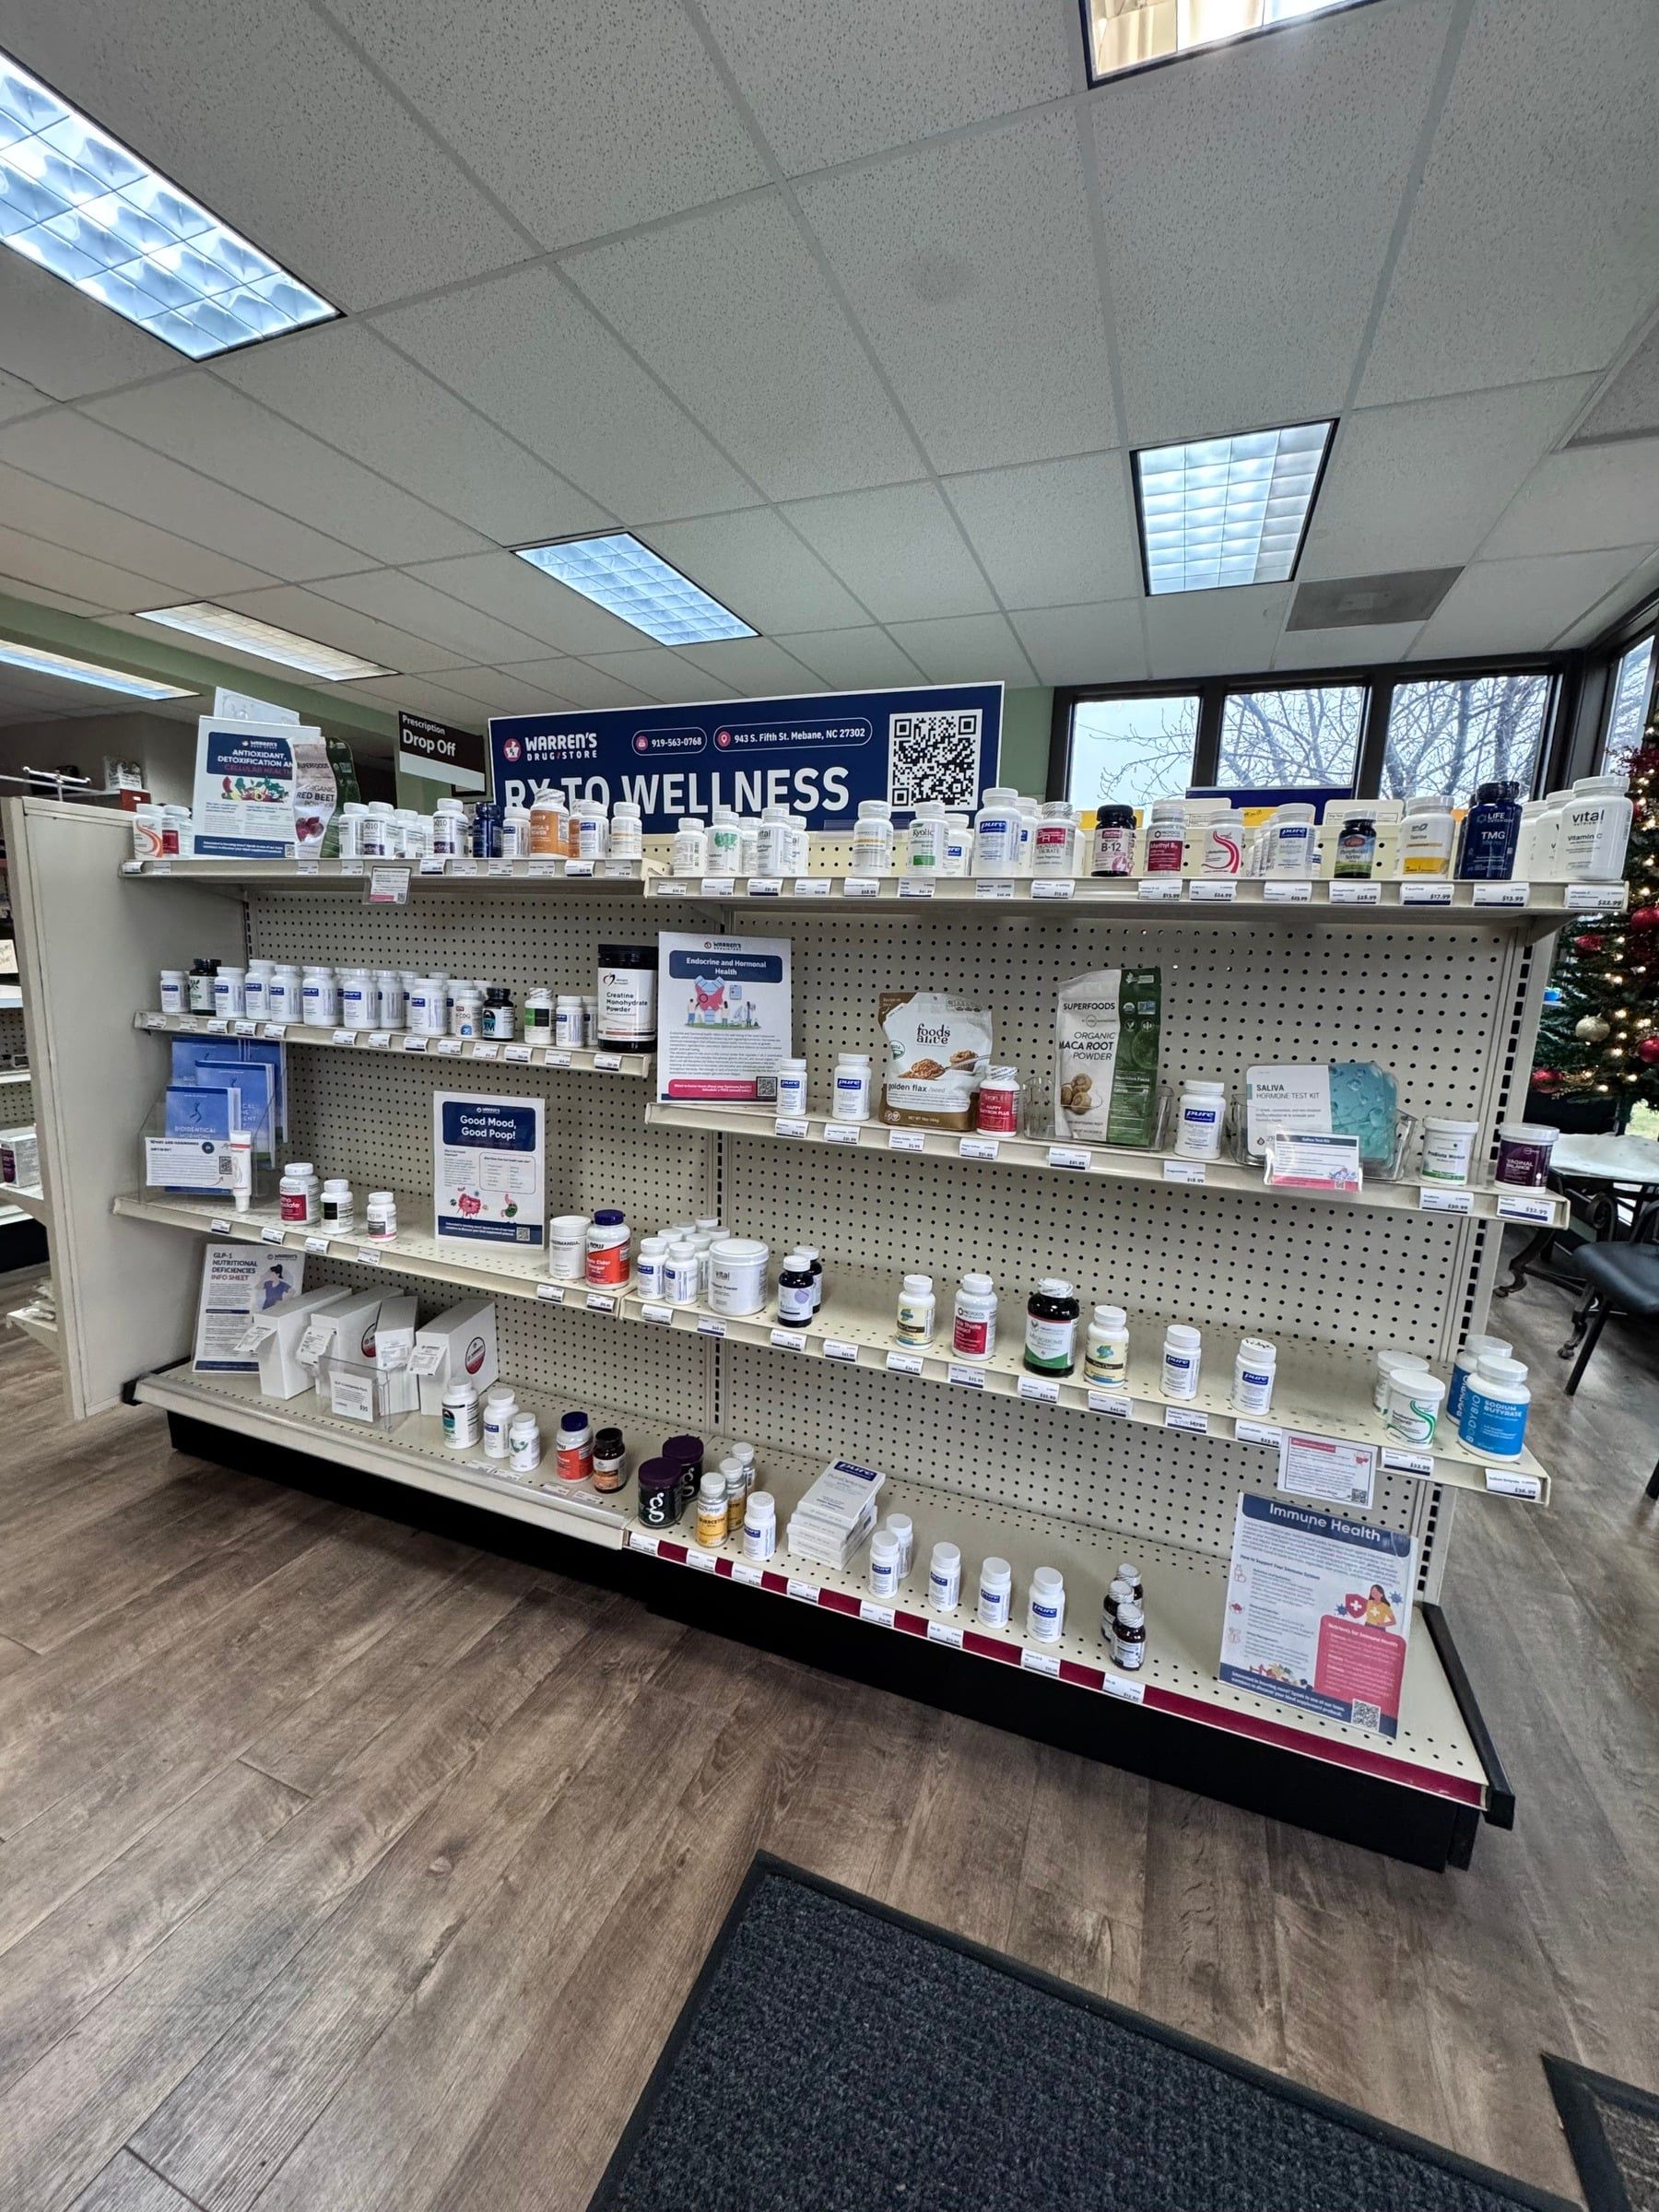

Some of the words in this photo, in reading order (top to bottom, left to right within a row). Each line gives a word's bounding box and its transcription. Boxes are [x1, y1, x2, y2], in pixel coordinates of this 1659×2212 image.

[402, 714, 445, 735] Prescription
[734, 734, 749, 744] 943
[749, 734, 759, 743] S.
[759, 733, 778, 743] Fifth
[779, 732, 790, 741] St.
[791, 730, 825, 741] Mebane,
[826, 729, 839, 738] NC
[839, 727, 865, 738] 27302
[403, 729, 435, 754] Drop
[437, 738, 457, 757] Off
[524, 732, 598, 752] WARREN'S
[652, 736, 702, 747] 919-563-0768
[231, 748, 287, 760] ANTIOXIDANT,
[217, 755, 282, 768] DETOXIFICATION
[560, 776, 611, 816] TO
[621, 766, 850, 816] WELLNESS
[296, 791, 312, 800] RED
[314, 793, 335, 803] BEET
[1571, 809, 1606, 824] vital
[981, 821, 1006, 830] pure
[912, 829, 935, 838] Kyolic
[1480, 830, 1506, 841] TMG
[1568, 833, 1594, 841] Vitamin
[1100, 842, 1122, 853] B-12
[686, 957, 720, 967] Endocrine
[735, 960, 767, 969] Hormonal
[714, 968, 737, 976] Health
[606, 998, 649, 1007] Monohydrate
[1063, 1002, 1116, 1011] SUPERFOODS
[916, 1023, 951, 1038] foods
[1074, 1031, 1116, 1041] ORGANIC
[916, 1035, 949, 1045] alive
[1086, 1041, 1114, 1051] ROOT
[1072, 1053, 1113, 1061] POWDER
[888, 1083, 911, 1093] golden
[912, 1082, 927, 1092] flax
[1255, 1084, 1285, 1092] SALIVA
[1185, 1109, 1216, 1119] pure
[459, 1114, 486, 1125] Good
[488, 1117, 517, 1130] Mood,
[461, 1126, 488, 1137] Good
[489, 1129, 516, 1142] Poop!
[212, 1259, 258, 1267] NUTRITIONAL
[211, 1266, 256, 1275] DEFICIENCIES
[1484, 1400, 1517, 1411] SODIUM
[1483, 1406, 1523, 1418] BUTYRATE
[1465, 1394, 1481, 1443] BODYBIO
[839, 1462, 875, 1477] pure
[648, 1492, 665, 1523] g
[1269, 1502, 1327, 1528] Immune
[1330, 1518, 1382, 1543] Health
